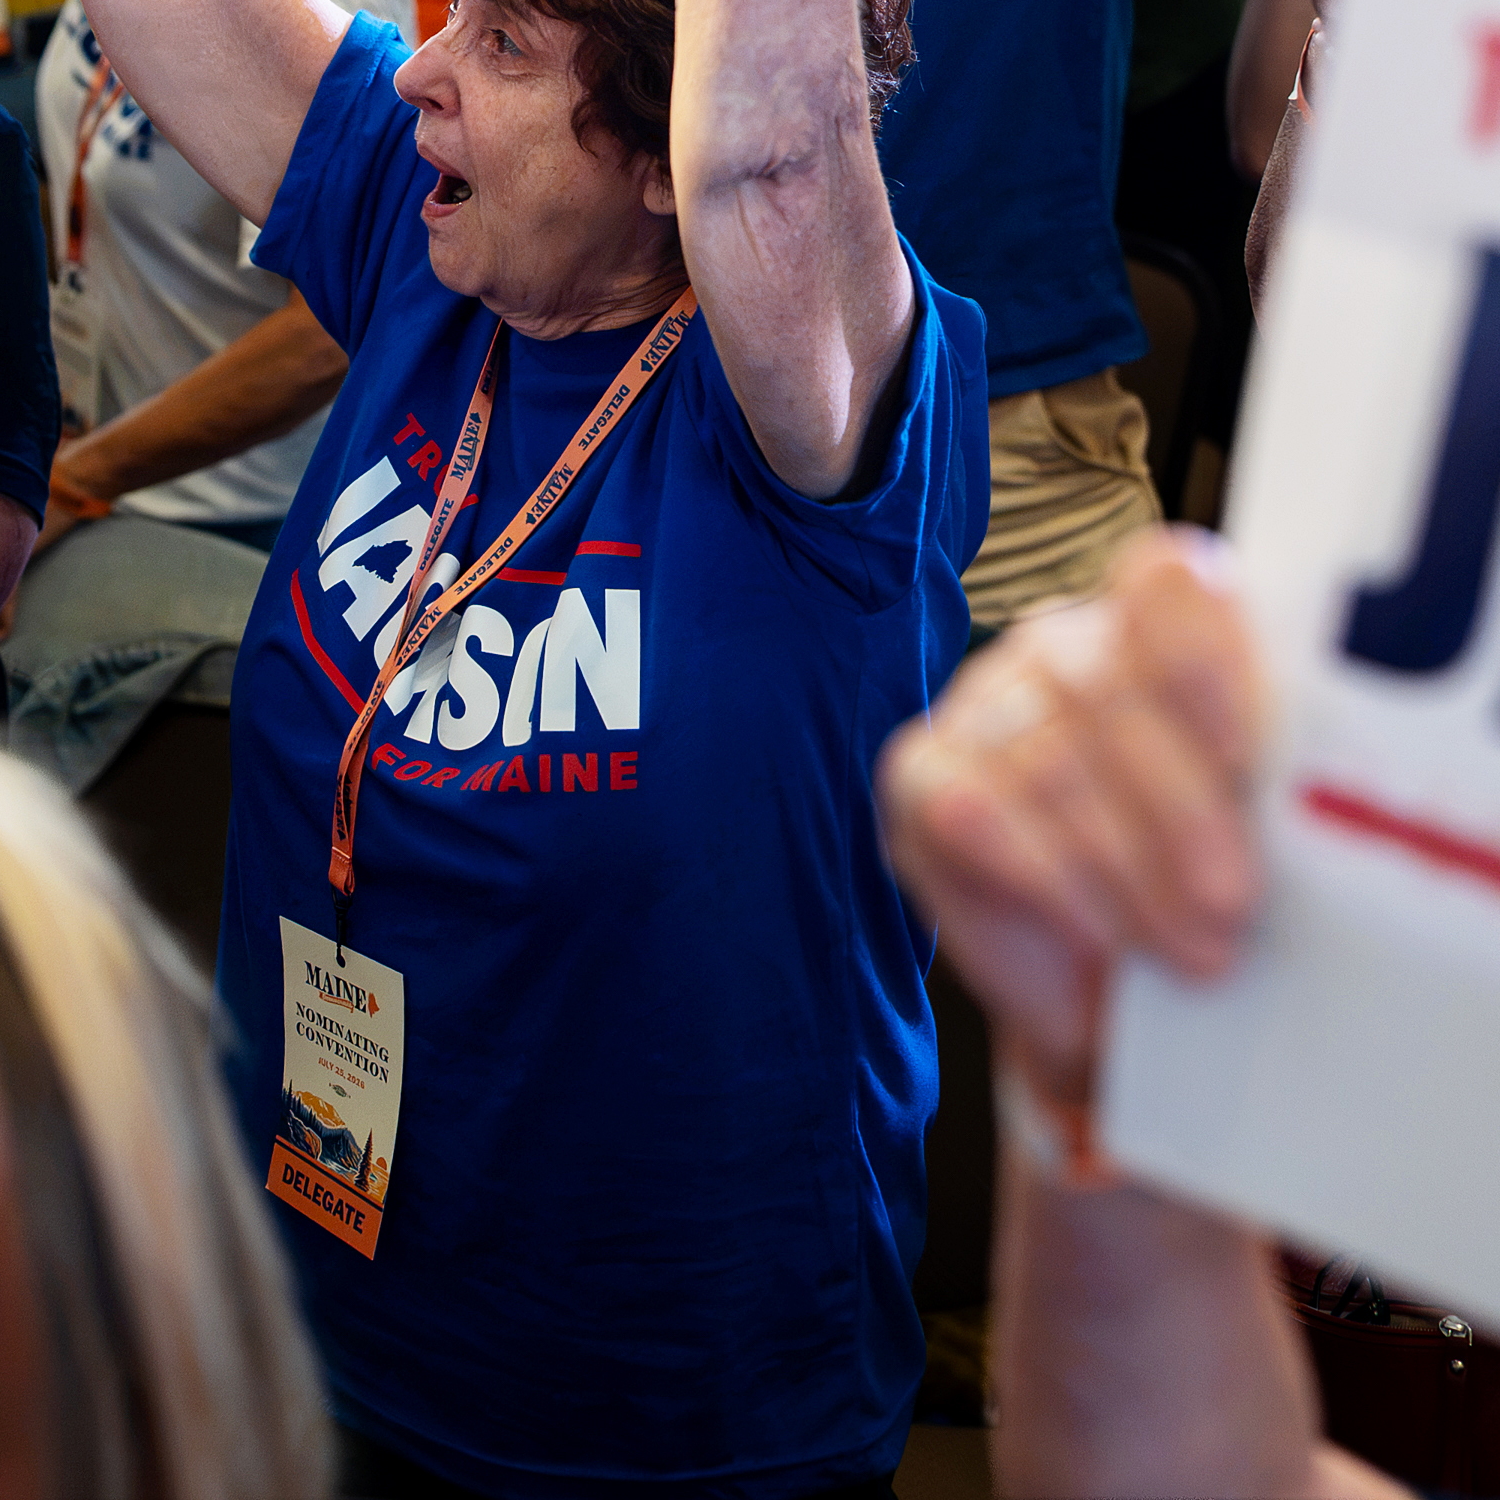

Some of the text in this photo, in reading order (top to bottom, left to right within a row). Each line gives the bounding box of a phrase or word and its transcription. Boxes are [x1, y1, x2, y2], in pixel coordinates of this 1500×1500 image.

[643, 310, 692, 371] MAINE
[578, 384, 631, 451] DELEGATE
[450, 420, 481, 481] MAINE
[530, 462, 575, 520] MAINE
[419, 497, 455, 571] DELEGATE
[455, 536, 514, 595] DELEGATE
[402, 606, 443, 659] MAINE
[371, 741, 639, 793] FOR MAINE
[304, 960, 367, 1014] MAINE
[295, 1001, 389, 1064] NOMINATING
[295, 1021, 389, 1084] CONVENTION
[318, 1056, 335, 1071] JULY
[281, 1162, 366, 1236] DELEGATE
